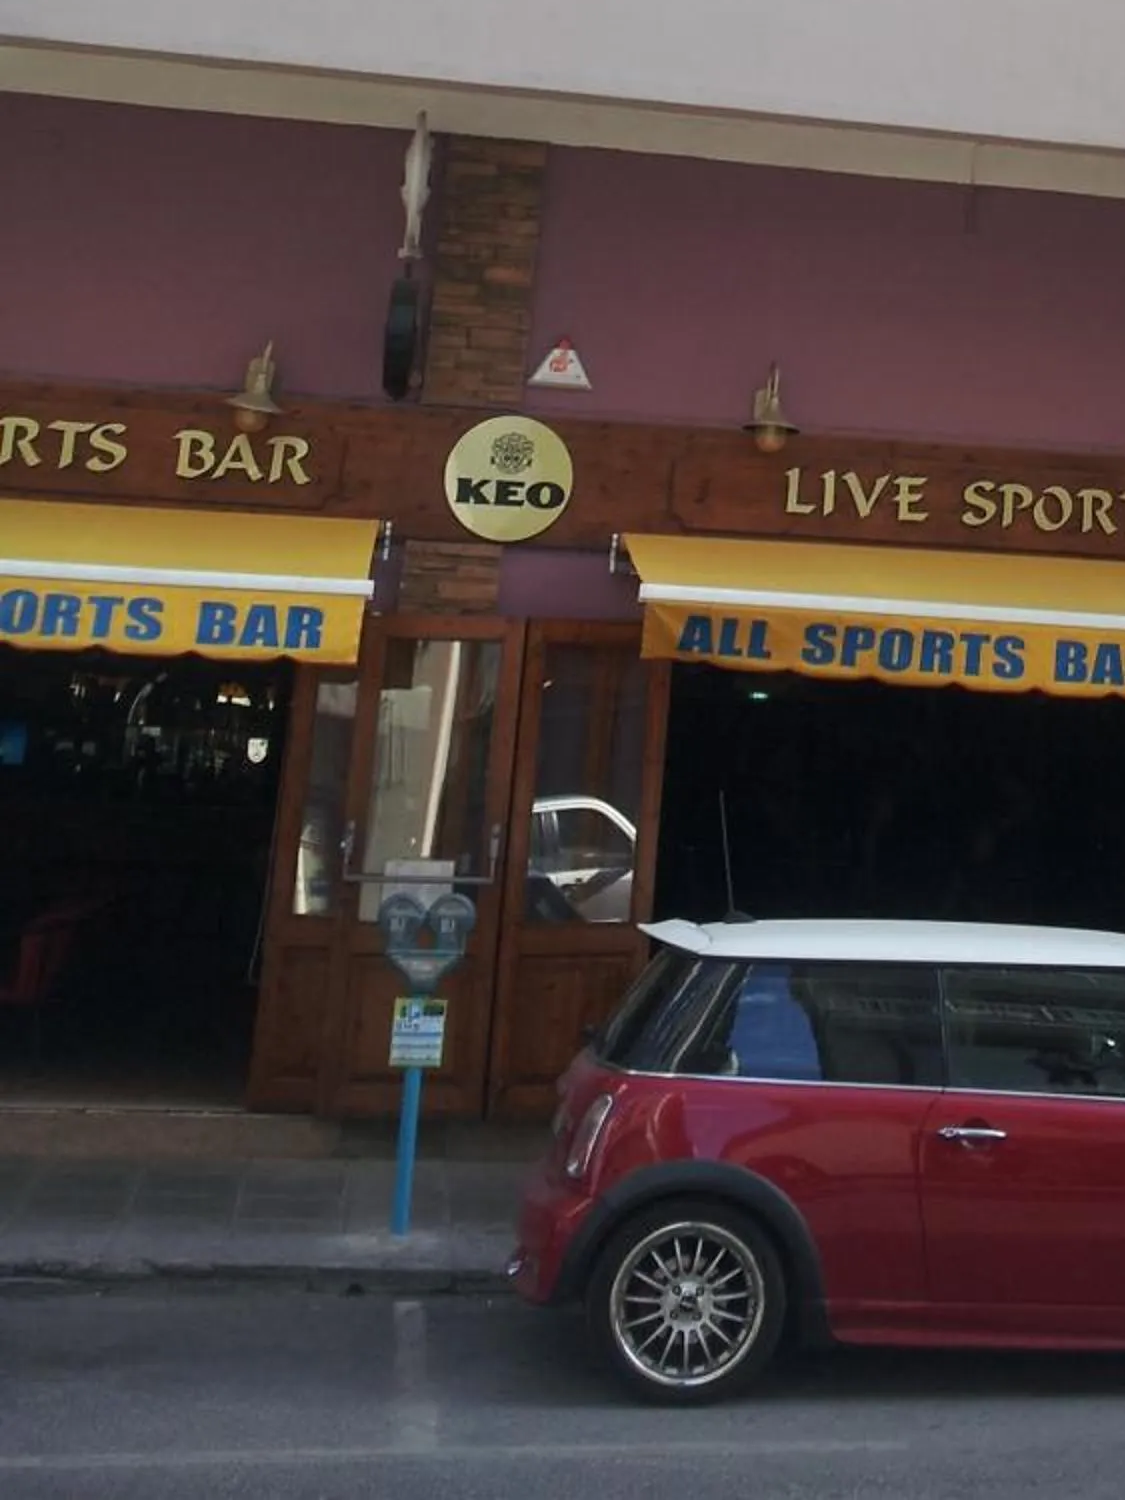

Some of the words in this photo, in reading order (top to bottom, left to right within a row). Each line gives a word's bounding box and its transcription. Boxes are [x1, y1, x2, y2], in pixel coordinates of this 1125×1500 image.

[0, 416, 128, 472] RTS
[173, 429, 311, 485] BAR
[455, 477, 566, 509] KEO
[784, 466, 930, 523] LIVE
[0, 588, 164, 642] ORTS
[195, 600, 325, 649] BAR
[675, 613, 772, 660] ALL
[801, 621, 1026, 681] SPORTS
